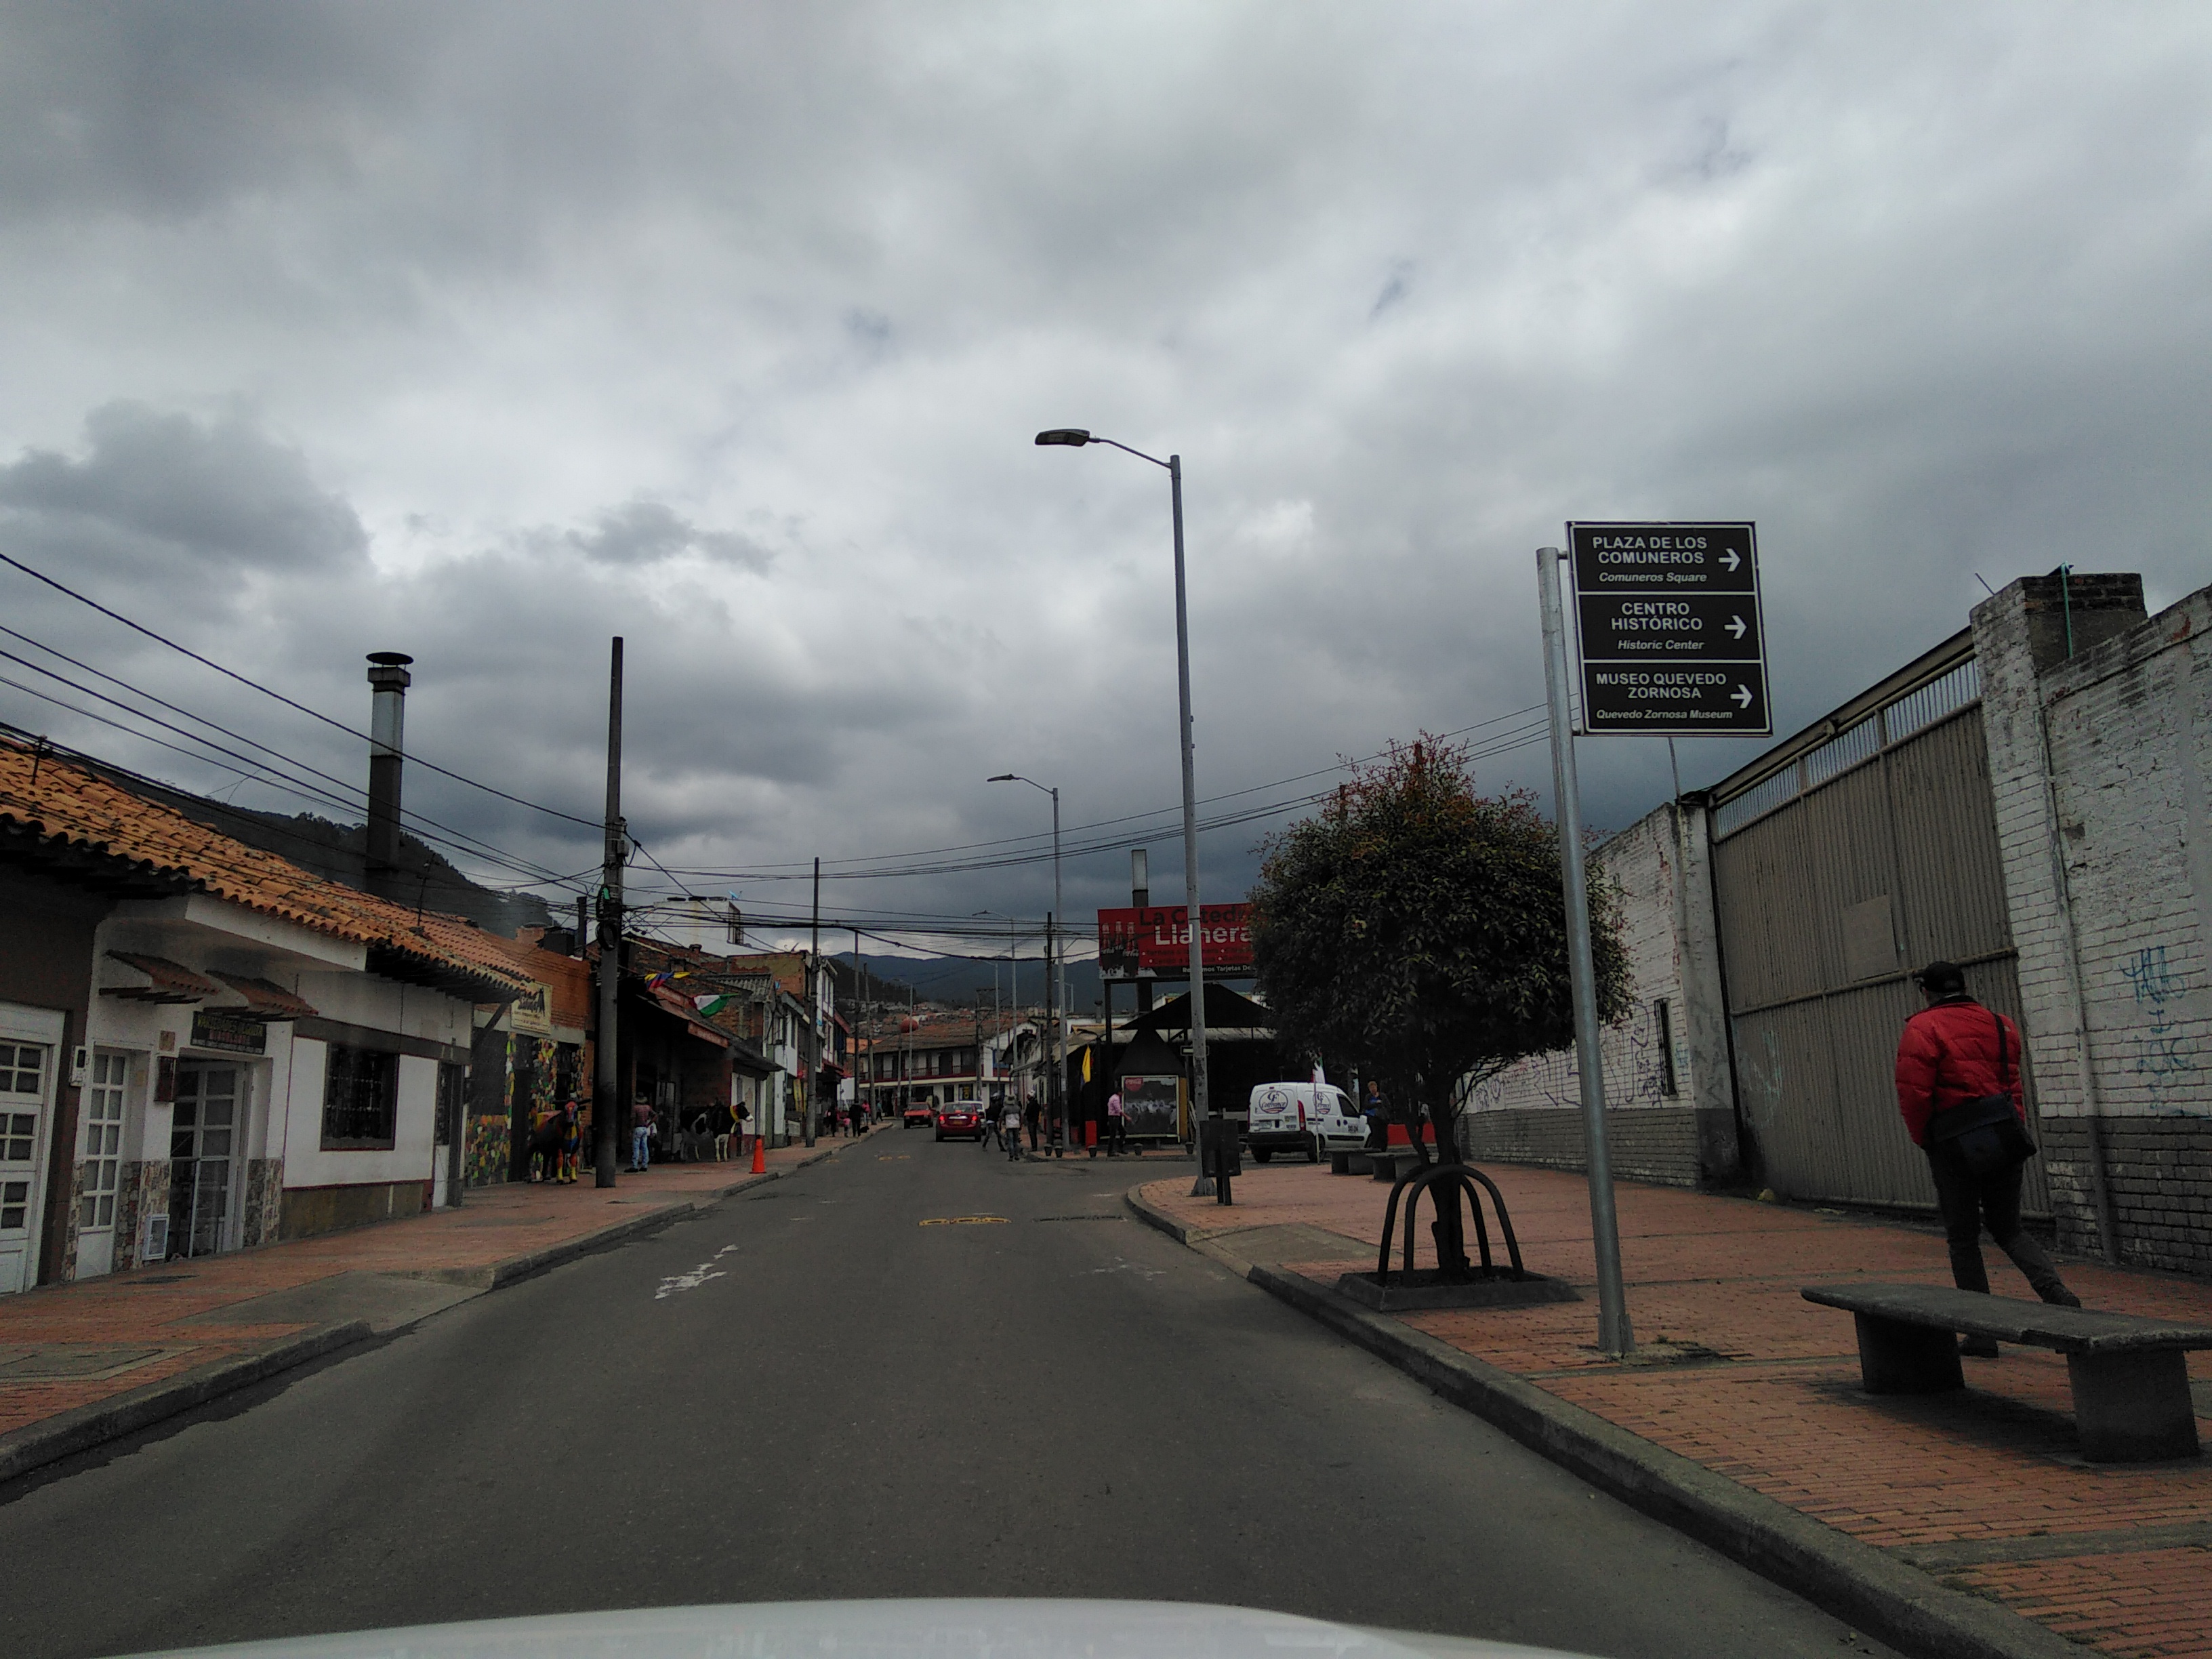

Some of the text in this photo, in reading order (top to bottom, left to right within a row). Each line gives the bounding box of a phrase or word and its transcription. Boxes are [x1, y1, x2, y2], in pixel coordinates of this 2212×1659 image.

[1592, 536, 1708, 549] PLAZA DE LOS
[1597, 552, 1705, 565] COMUNEROS
[1599, 572, 1707, 583] Comuneros Square
[1621, 602, 1690, 615] CENTRO
[1610, 615, 1703, 631] HISTÓRICO
[1618, 640, 1705, 650] Historic Center
[1595, 673, 1727, 685] MUSEO QUEVEDO
[1627, 687, 1702, 699] ZORNOSA
[1596, 710, 1733, 720] Quevedo Zornosa Museum
[1140, 908, 1165, 926] La
